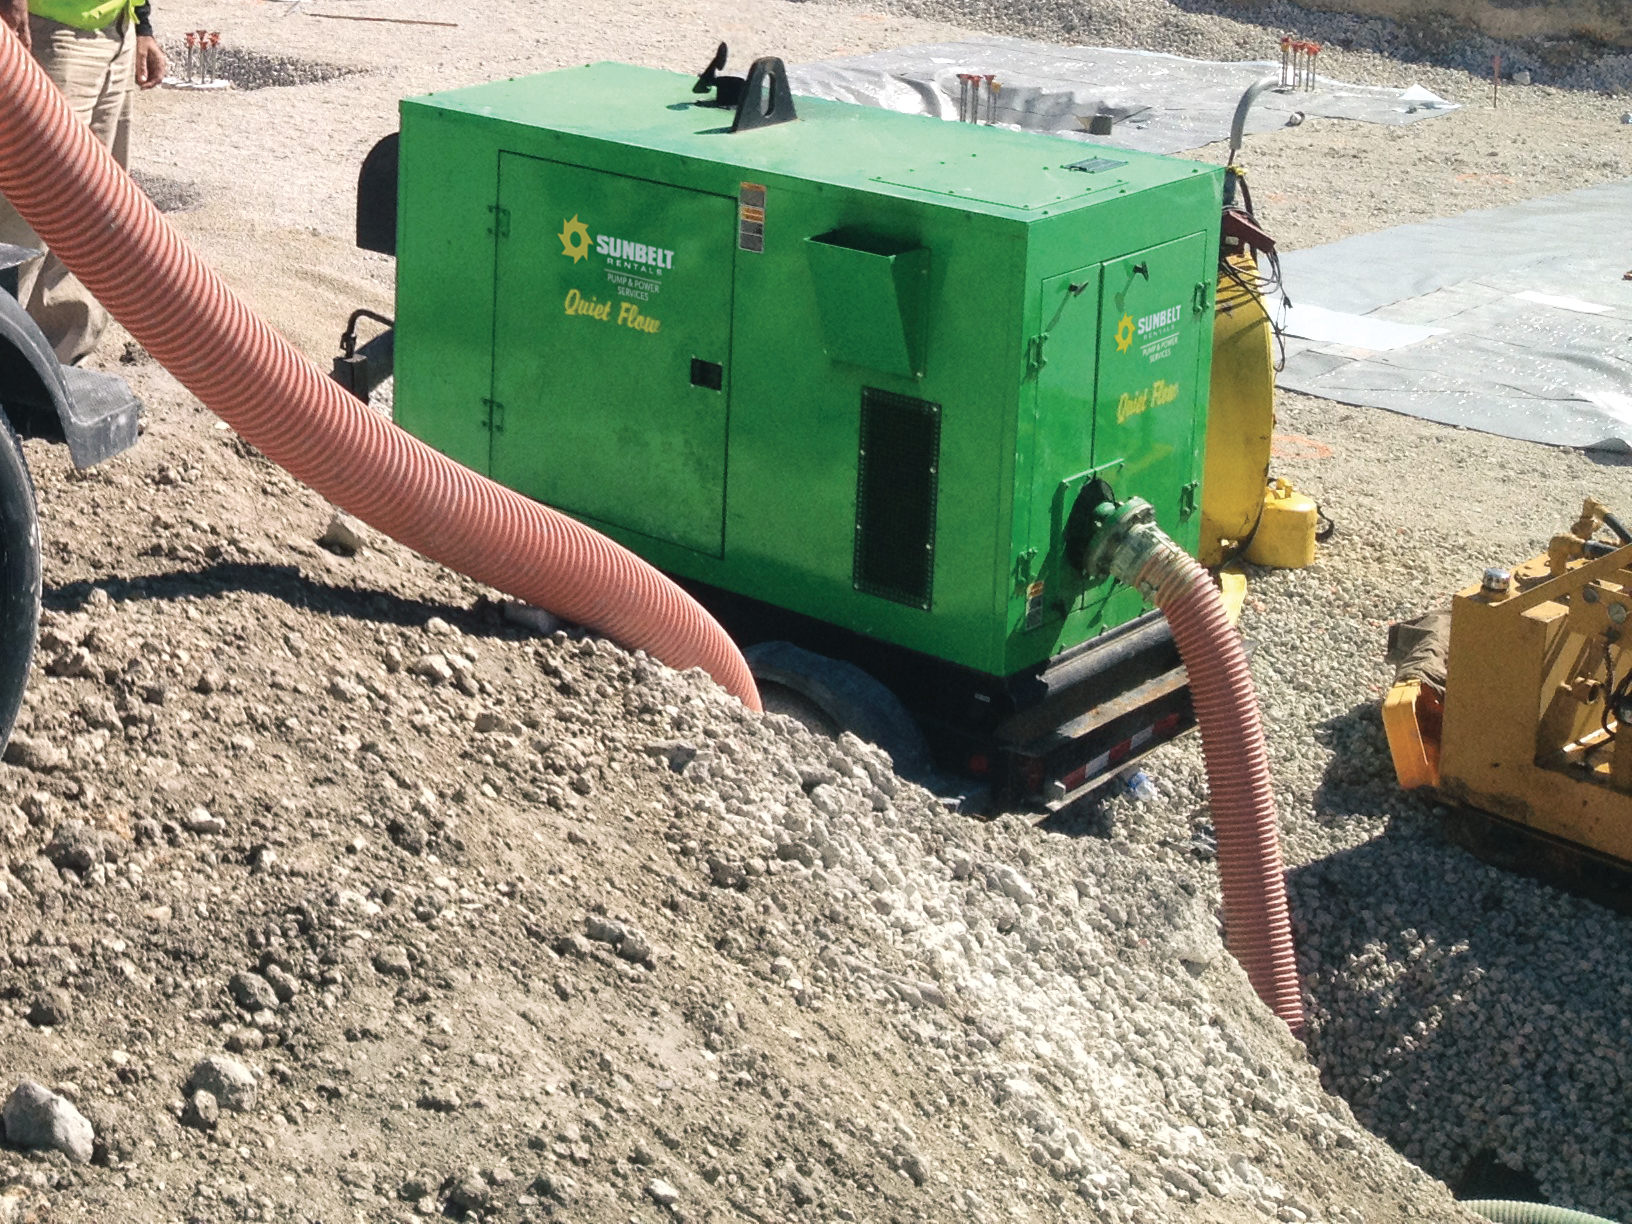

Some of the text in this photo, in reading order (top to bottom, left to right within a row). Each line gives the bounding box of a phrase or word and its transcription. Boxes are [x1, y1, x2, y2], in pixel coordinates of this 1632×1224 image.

[596, 234, 674, 269] SUNBELT
[606, 257, 662, 276] RENTALS
[607, 273, 627, 285] PUMP
[634, 280, 659, 294] POWER
[617, 286, 649, 301] SERVICES
[564, 289, 660, 333] Quiet Flow
[1137, 305, 1181, 335] SUNBELT
